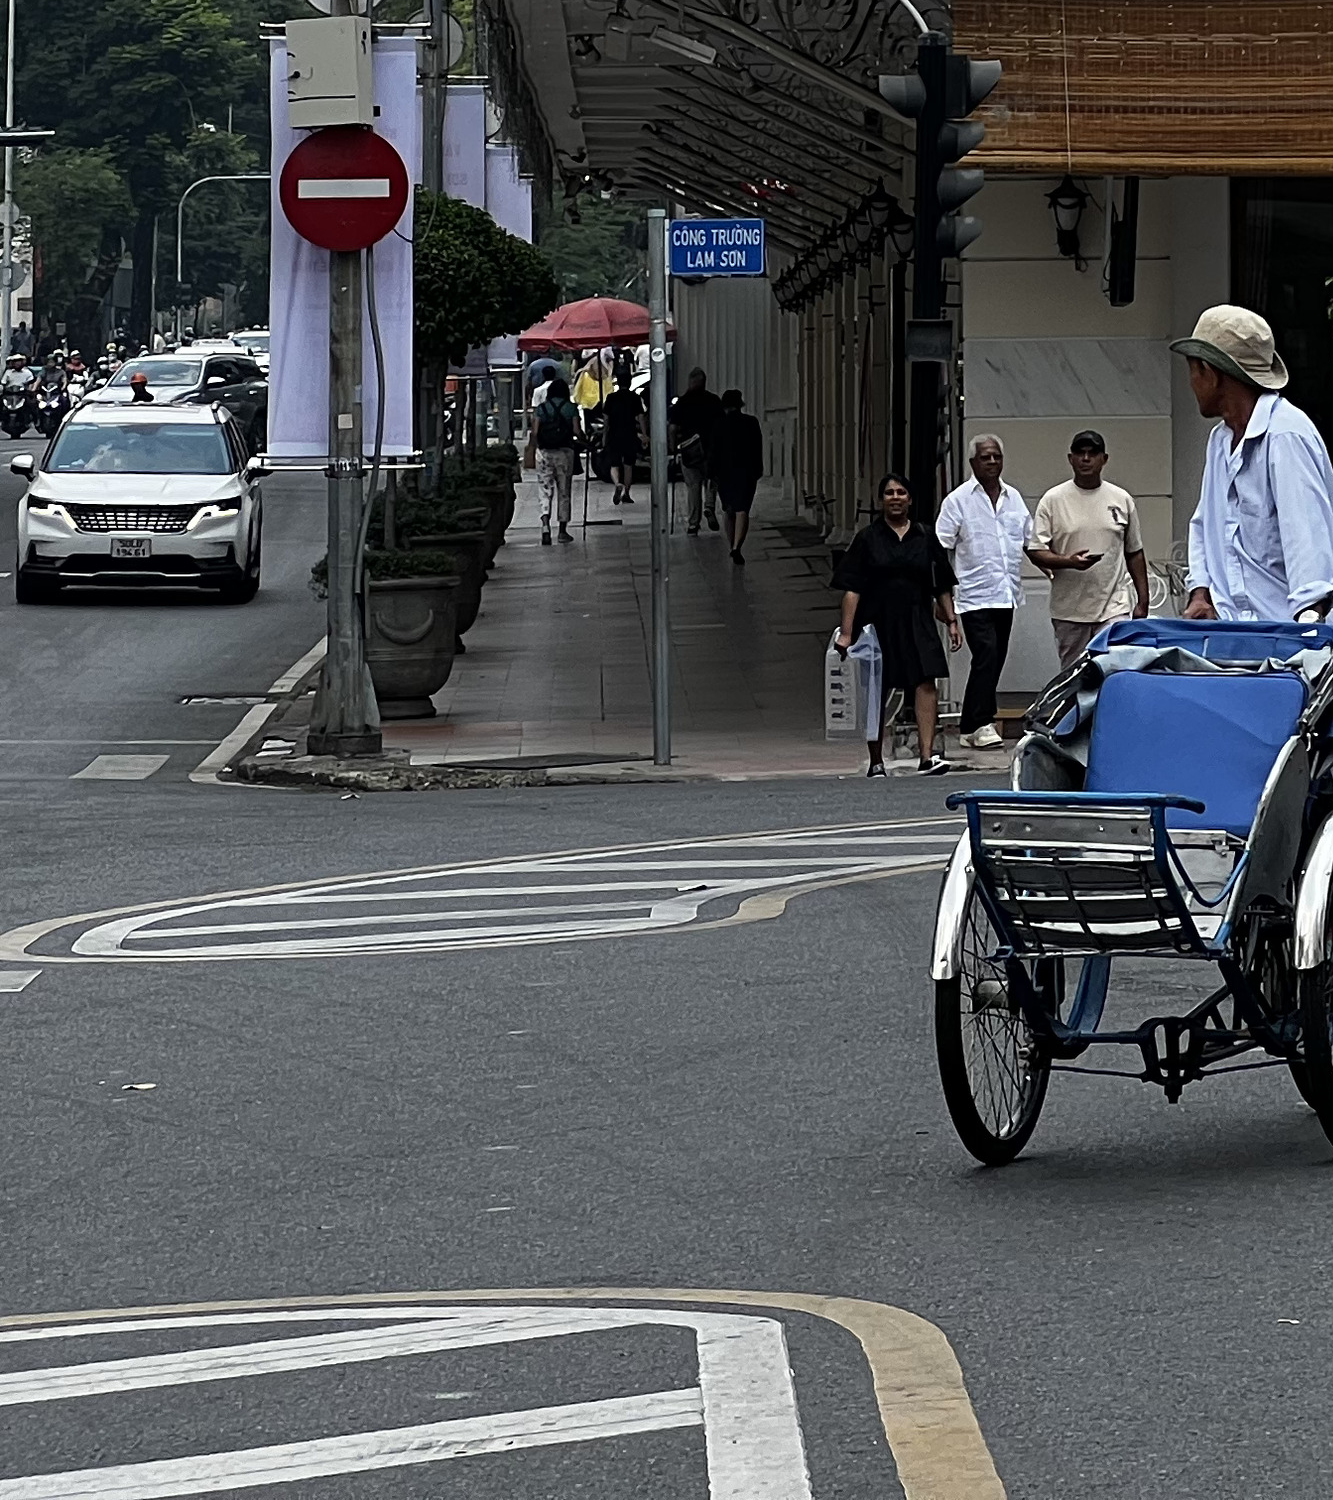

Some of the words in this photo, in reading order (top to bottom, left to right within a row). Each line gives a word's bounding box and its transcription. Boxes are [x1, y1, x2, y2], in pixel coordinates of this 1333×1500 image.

[673, 225, 706, 246] CÔNG
[711, 223, 760, 246] TRƯỜNG
[687, 251, 715, 268] LAM
[719, 249, 746, 267] SƠN
